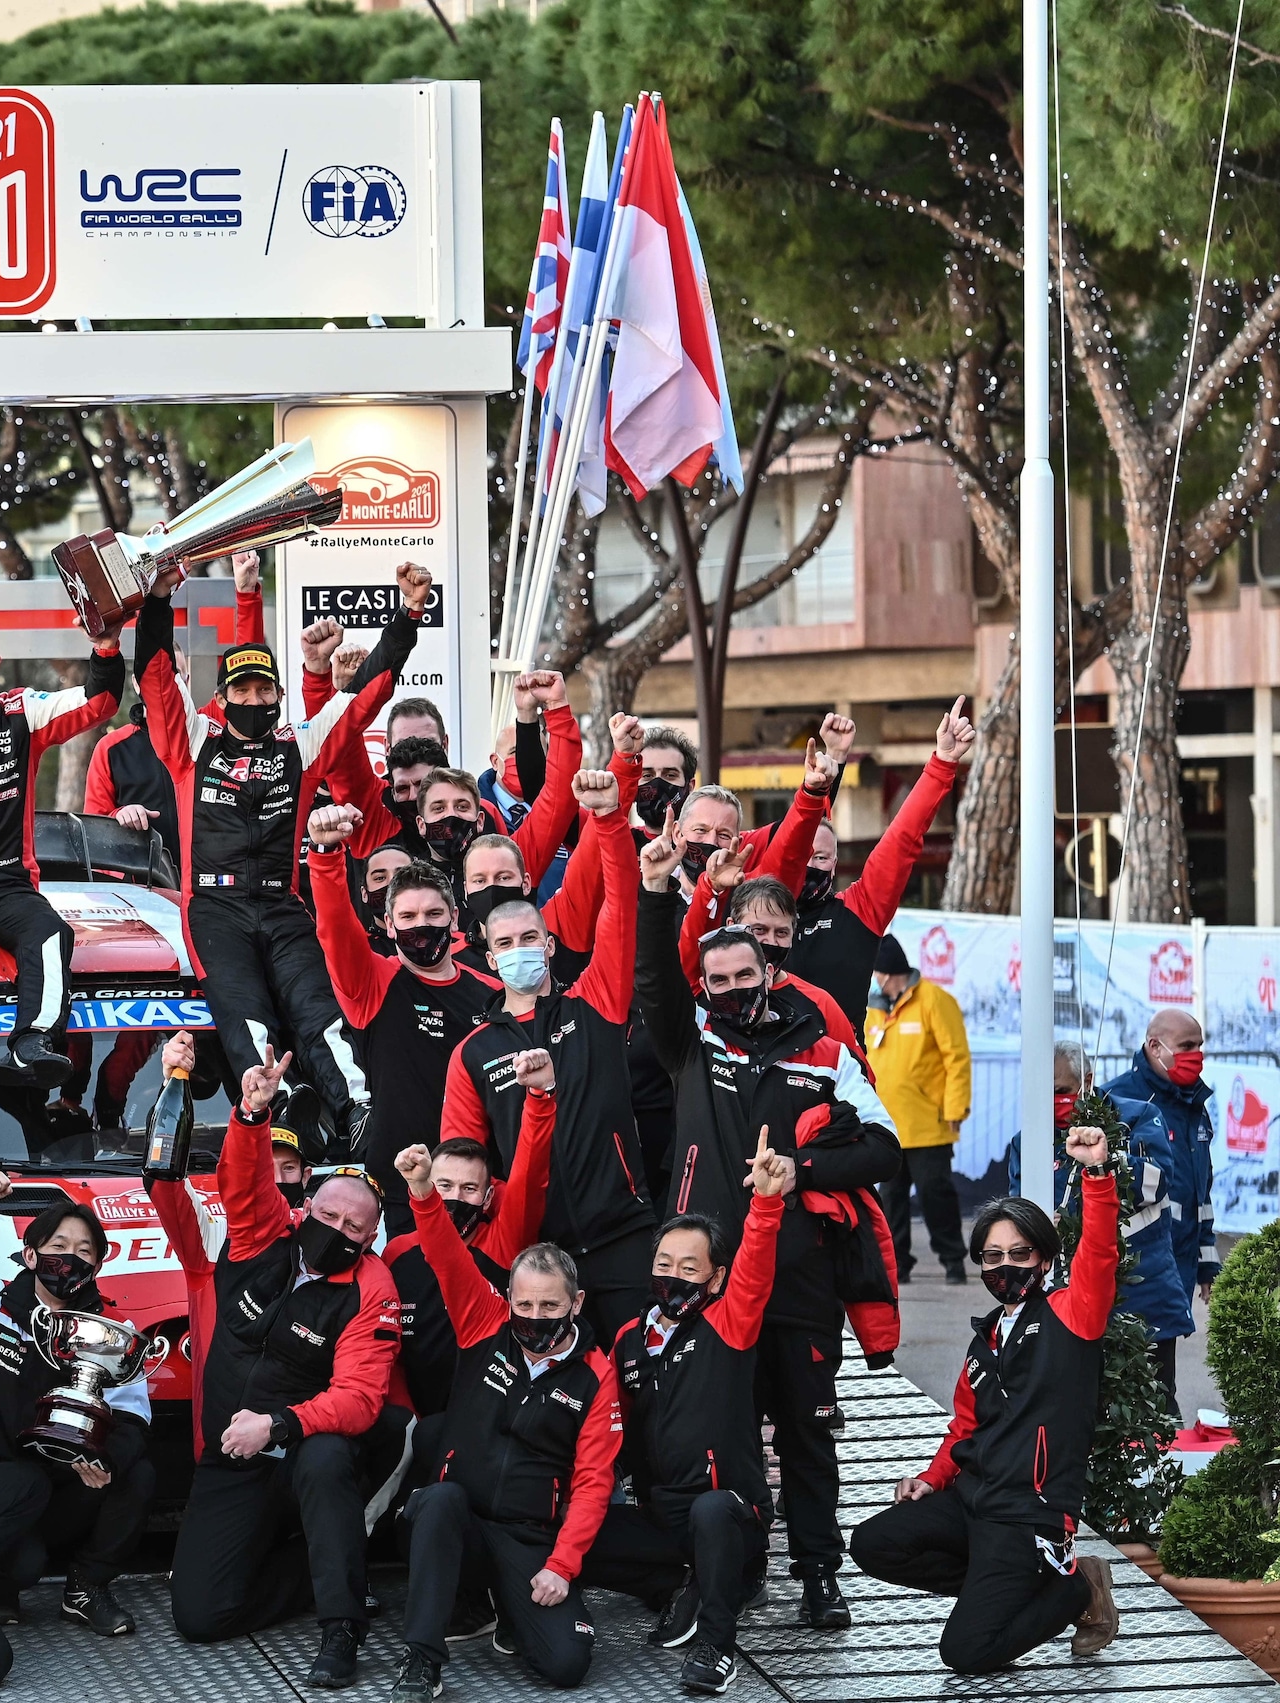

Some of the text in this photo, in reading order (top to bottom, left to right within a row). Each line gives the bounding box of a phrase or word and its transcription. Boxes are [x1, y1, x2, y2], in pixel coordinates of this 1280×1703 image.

[80, 168, 241, 203] WRC
[85, 213, 239, 224] FIA WORLD RALLY
[85, 230, 238, 238] CHAMPIONSHIP
[411, 482, 431, 498] 2021
[310, 536, 434, 548] #RallyeMonteCarlo
[305, 588, 440, 611] LE CASIO
[228, 653, 270, 668] PIRELLI
[396, 671, 443, 687] n.com
[254, 753, 285, 768] TOTA
[253, 762, 284, 775] GAOO
[220, 780, 241, 791] MORI
[266, 784, 290, 798] NSO
[220, 791, 235, 802] CCI
[269, 880, 283, 888] OGIER
[95, 990, 184, 998] GAZOO
[711, 1064, 734, 1078] DEN
[103, 1203, 147, 1219] RALLYE
[237, 1299, 257, 1321] DENSO
